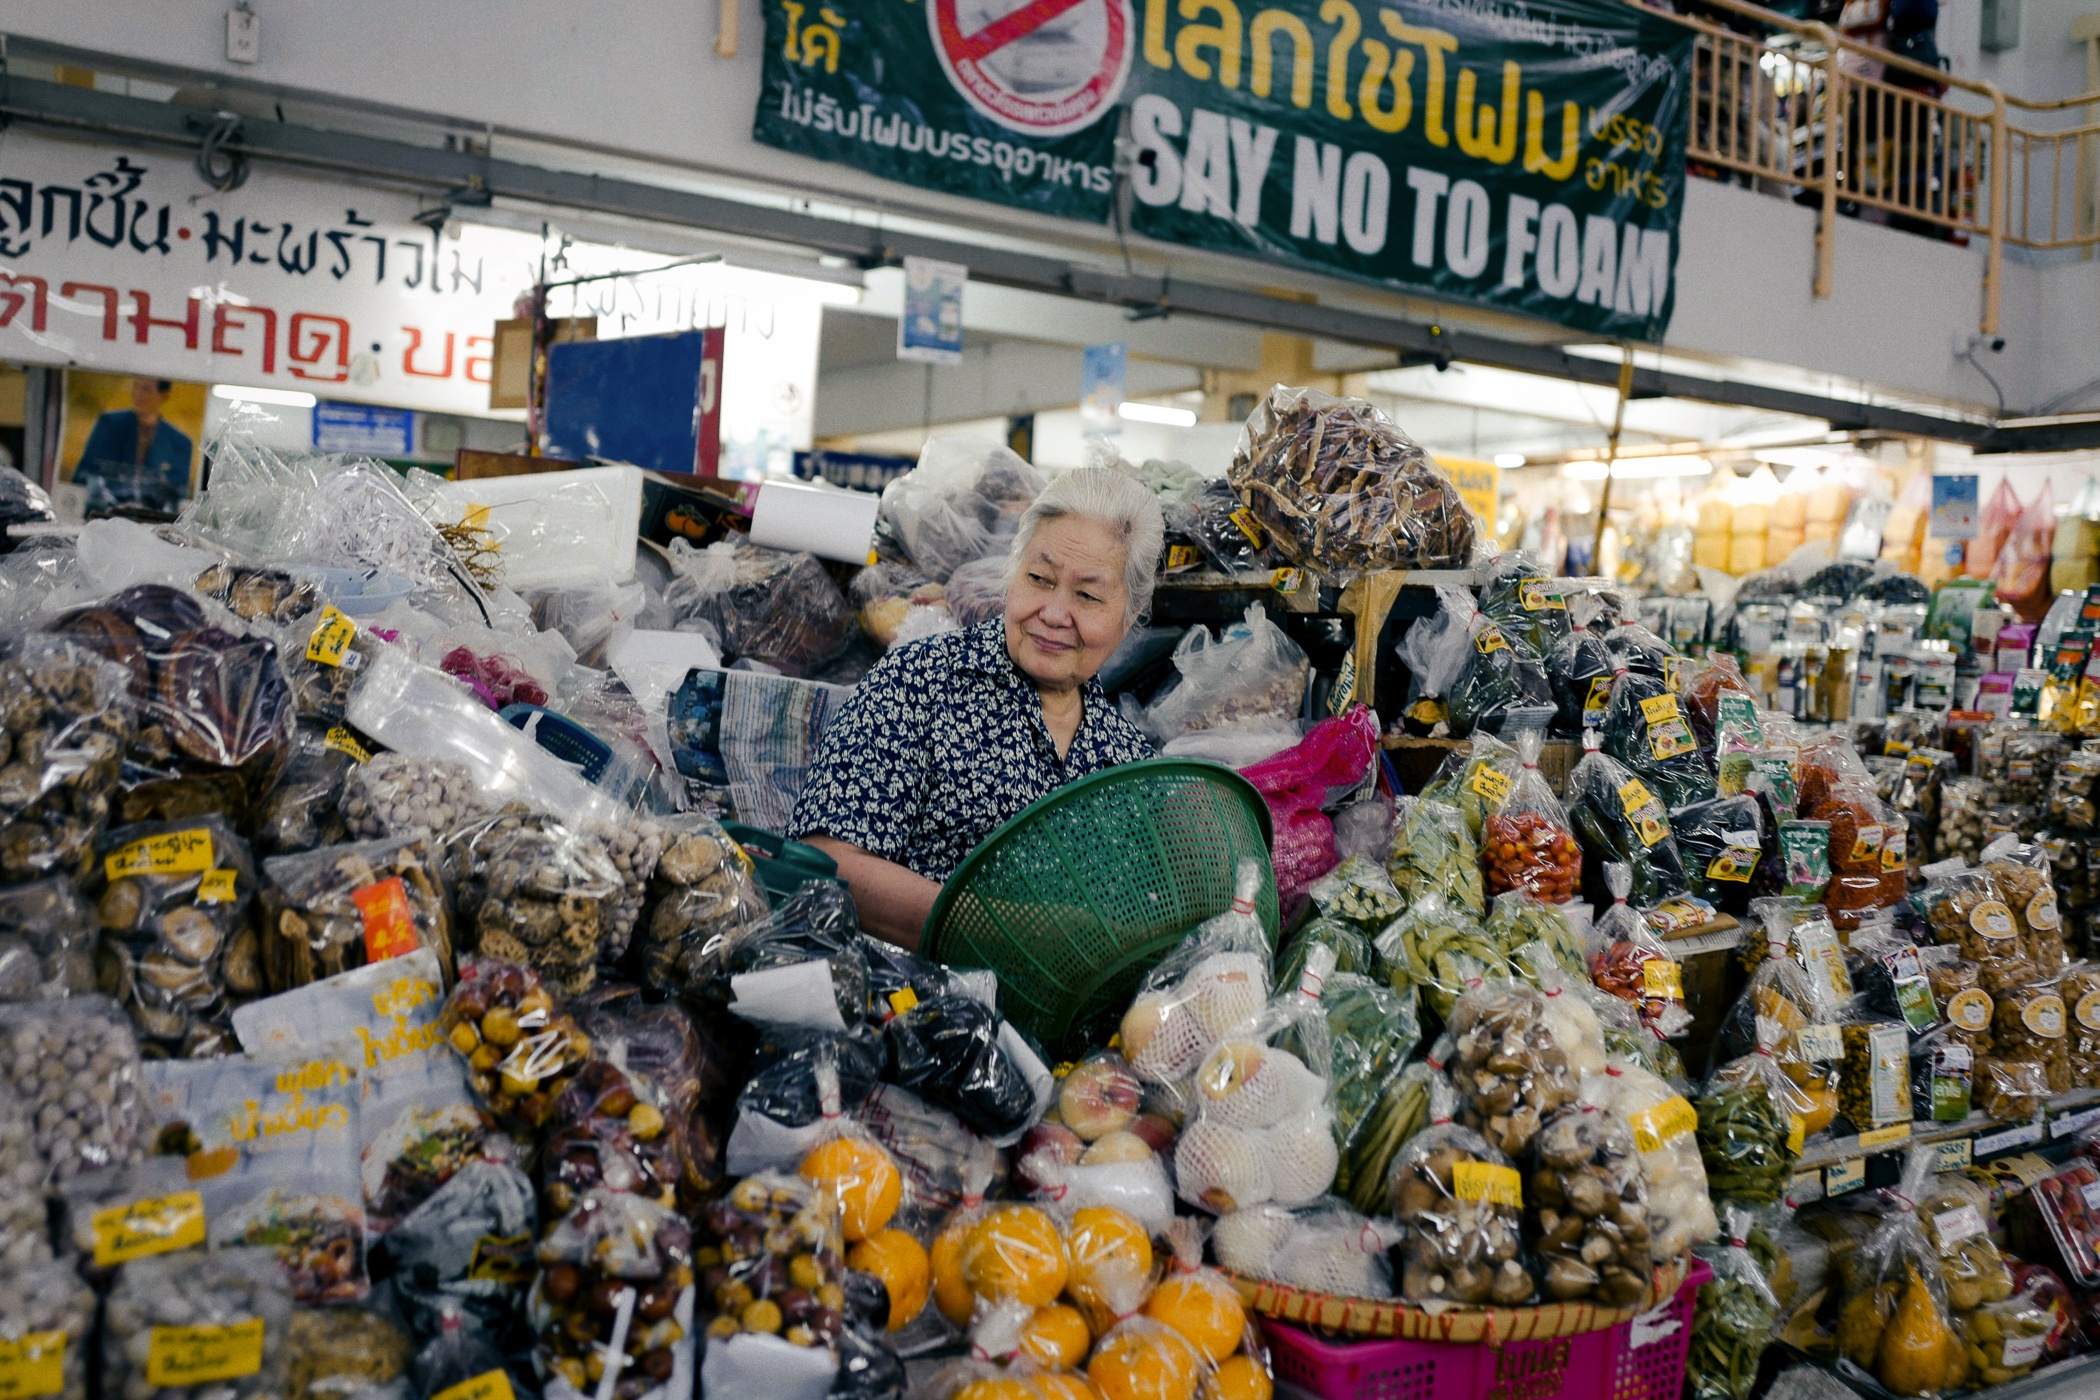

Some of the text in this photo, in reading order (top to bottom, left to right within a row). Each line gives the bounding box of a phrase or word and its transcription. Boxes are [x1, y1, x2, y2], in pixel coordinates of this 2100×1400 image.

[782, 0, 847, 74] ได้
[1130, 94, 1670, 318] SAY NO TO FOAM
